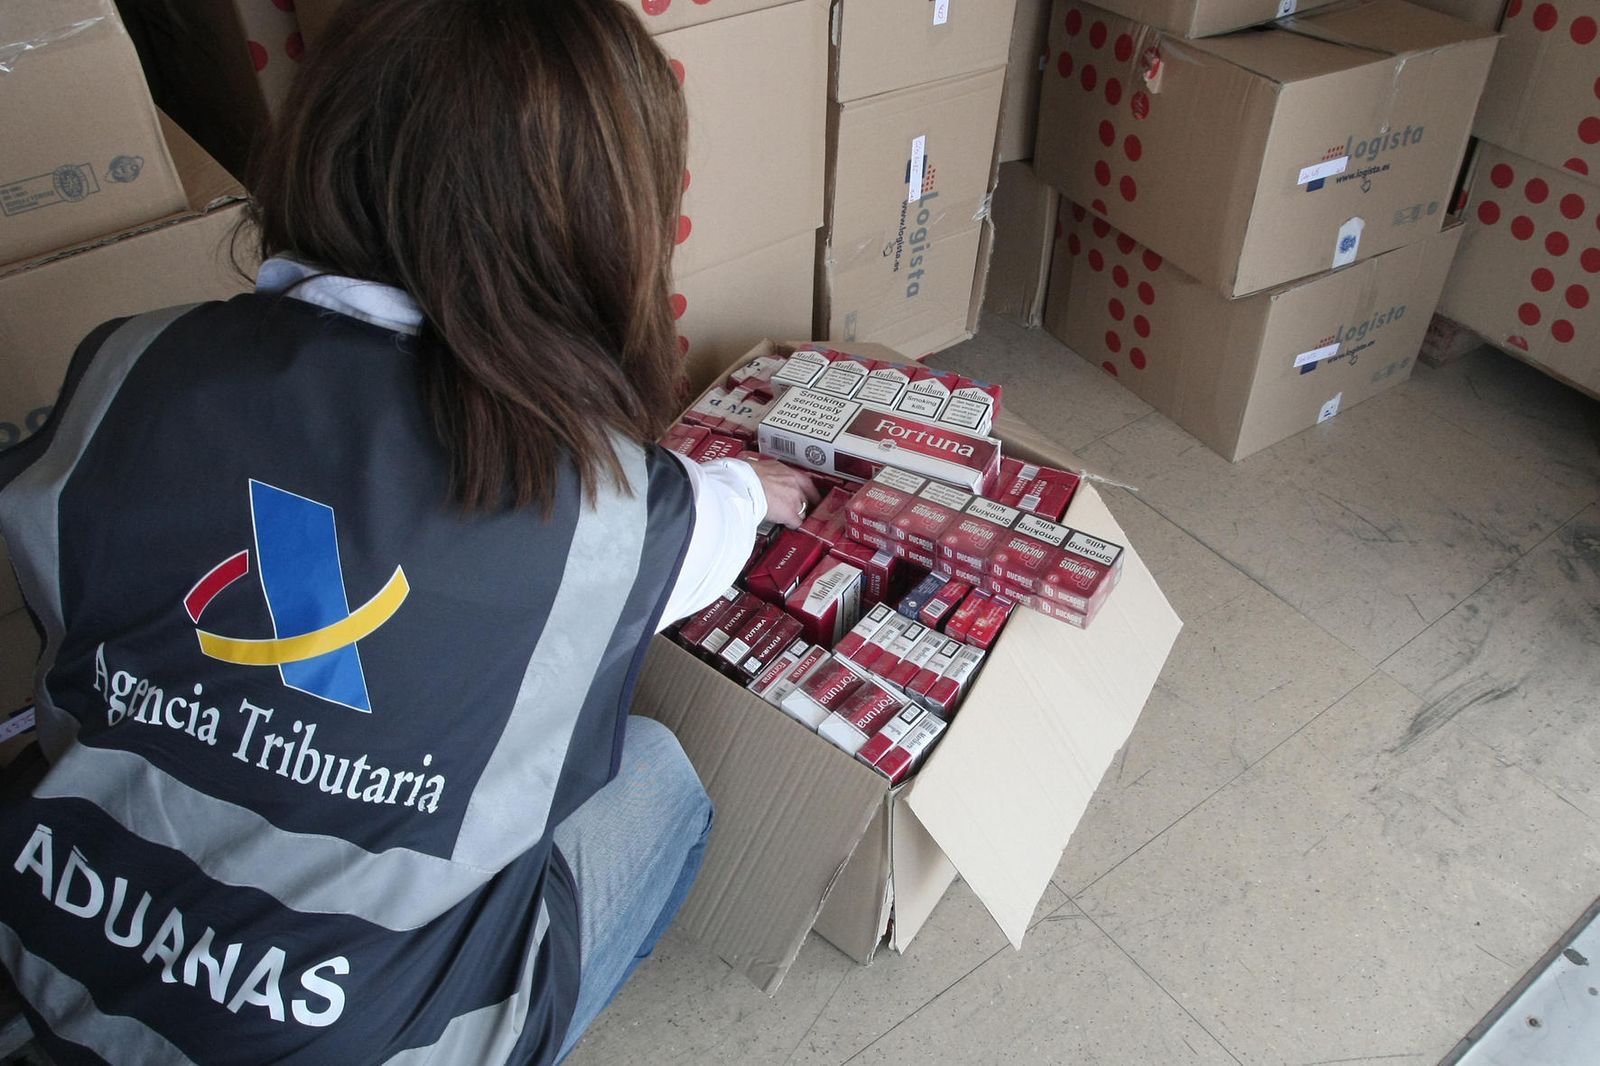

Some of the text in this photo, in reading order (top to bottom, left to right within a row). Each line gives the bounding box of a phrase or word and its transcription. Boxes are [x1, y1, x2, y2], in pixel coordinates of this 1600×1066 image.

[1344, 123, 1425, 162] Logista
[893, 200, 909, 272] www.logista.es
[906, 191, 939, 299] Logista
[1334, 305, 1407, 344] Logista
[833, 360, 865, 374] Marlboro
[874, 369, 905, 382] Marlboro
[799, 389, 846, 409] Smoking
[911, 380, 946, 398] Marlboro
[957, 389, 990, 403] Marlboro
[783, 402, 840, 422] harms you
[792, 397, 843, 416] seriously
[769, 415, 831, 438] around you
[777, 408, 835, 429] and others
[873, 418, 976, 459] Fortuna
[969, 505, 1011, 526] Smoking
[986, 502, 1007, 514] kills
[1018, 522, 1061, 545] Smoking
[1035, 519, 1056, 532] kills
[1068, 541, 1113, 564] Smoking
[1085, 538, 1107, 551] kills
[810, 571, 844, 600] Marlboro
[702, 600, 724, 622] FUTURA
[724, 608, 747, 631] FUTURA
[744, 618, 767, 641] FUTURA
[758, 635, 782, 659] FUTURA
[761, 661, 787, 684] Fortuna
[793, 655, 817, 678] Fortuna
[820, 671, 858, 705] Fortuna
[855, 693, 895, 730] Fortuna
[93, 641, 446, 814] Agencia Tributaria
[13, 823, 352, 1028] ADUANAS
